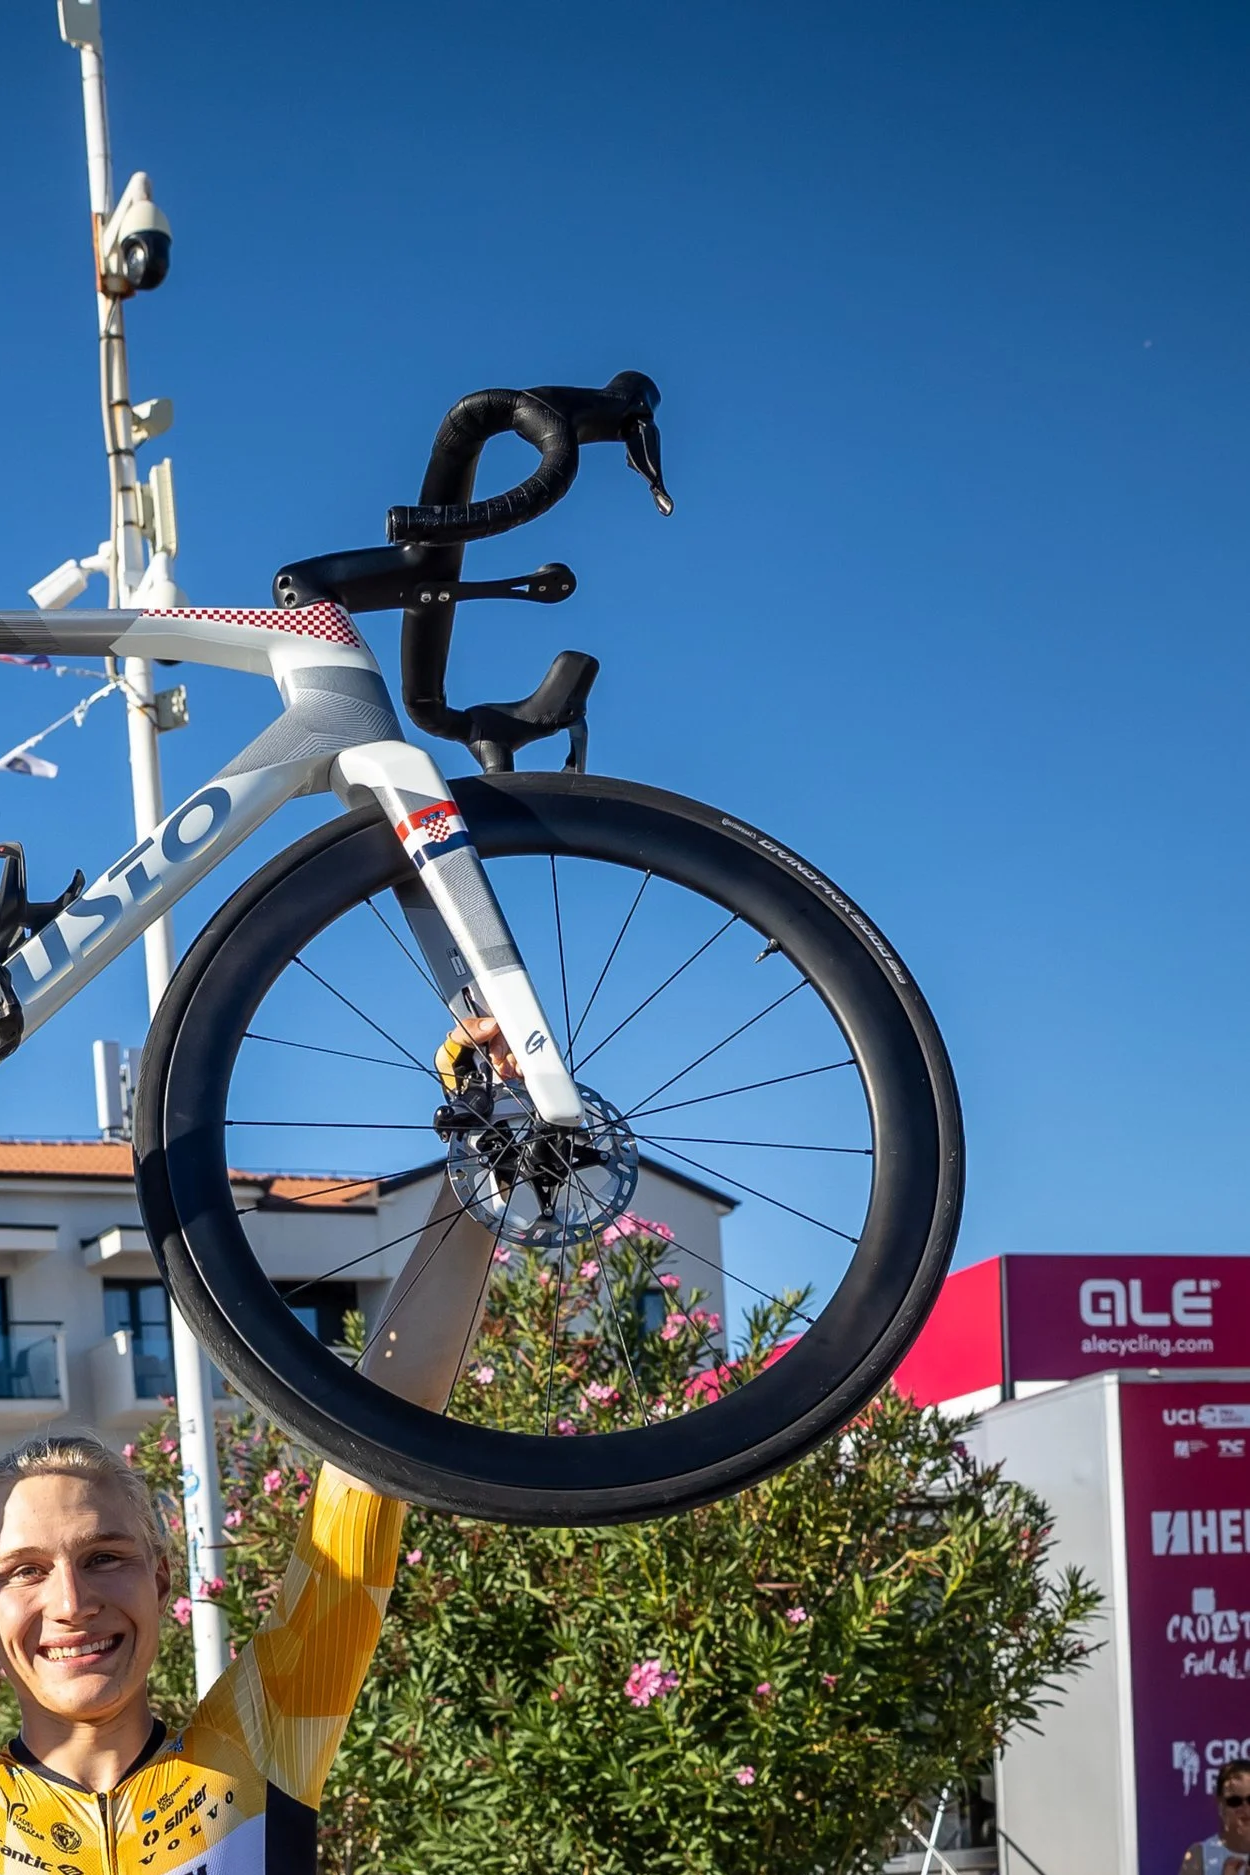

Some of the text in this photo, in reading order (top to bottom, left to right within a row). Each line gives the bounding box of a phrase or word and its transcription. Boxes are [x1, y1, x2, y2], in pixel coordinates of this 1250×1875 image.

[758, 838, 820, 882] GRAND
[814, 880, 856, 914] PRIX
[850, 912, 892, 963] 5000
[1080, 1334, 1215, 1358] alecycling.com
[1161, 1408, 1197, 1426] UCI
[138, 1790, 234, 1866] VOLVO
